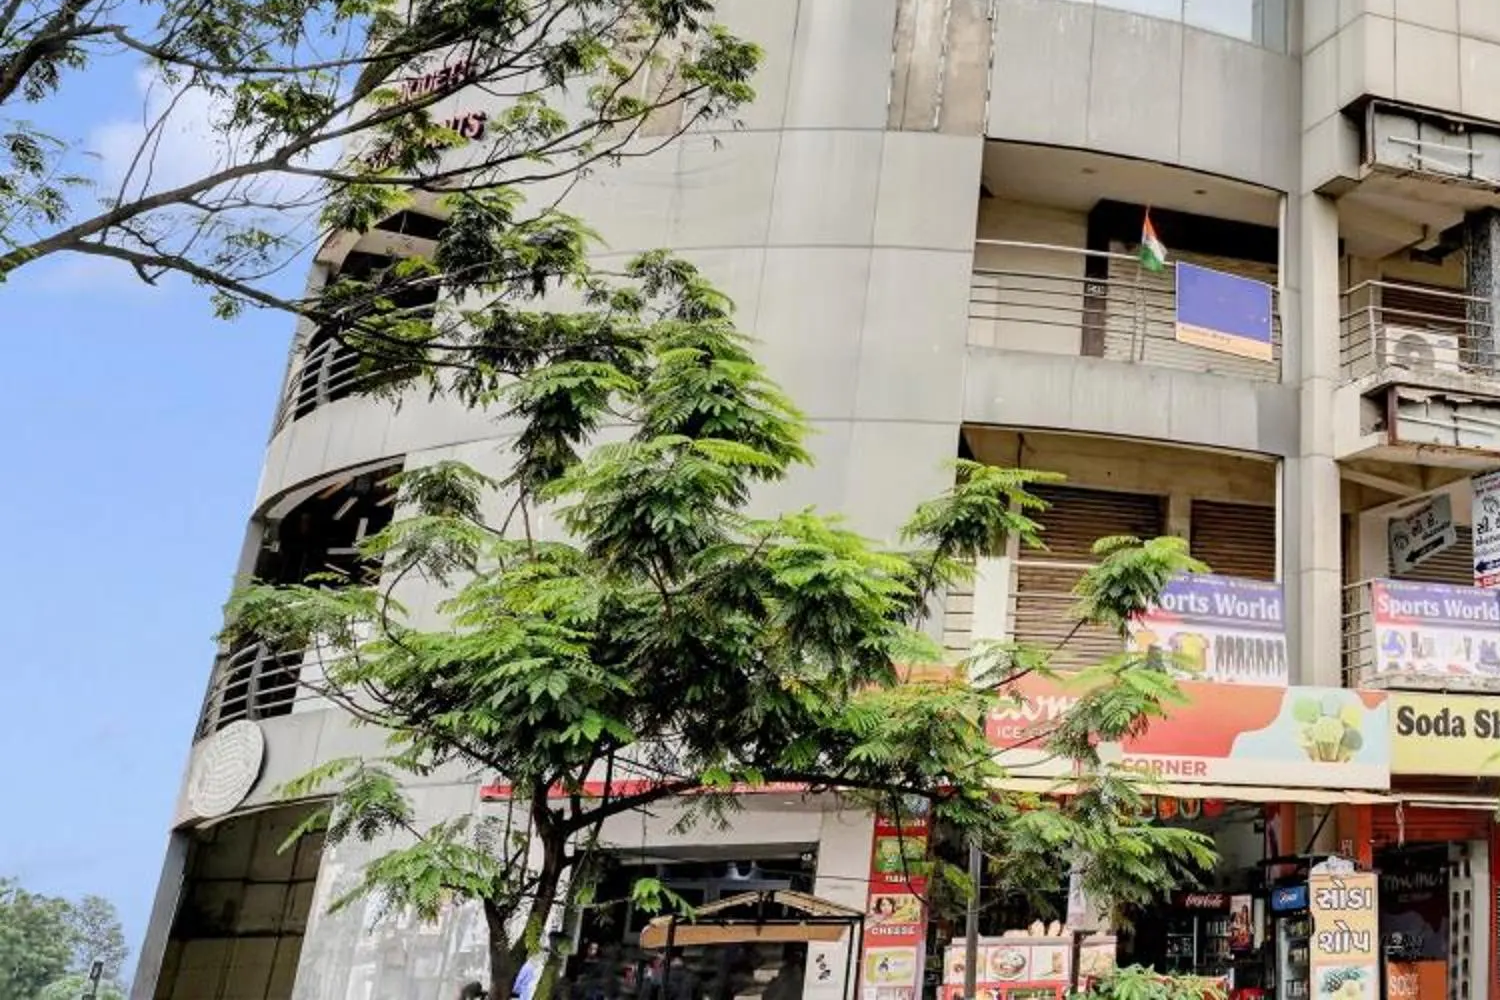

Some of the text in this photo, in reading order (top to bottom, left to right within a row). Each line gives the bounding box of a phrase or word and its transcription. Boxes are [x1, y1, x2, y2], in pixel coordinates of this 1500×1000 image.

[1212, 591, 1282, 621] World
[1377, 594, 1500, 622] Sports World
[1396, 705, 1467, 738] Soda
[1121, 757, 1208, 777] CORNER
[1316, 876, 1373, 911] સોડા
[1318, 919, 1371, 954] શોપ
